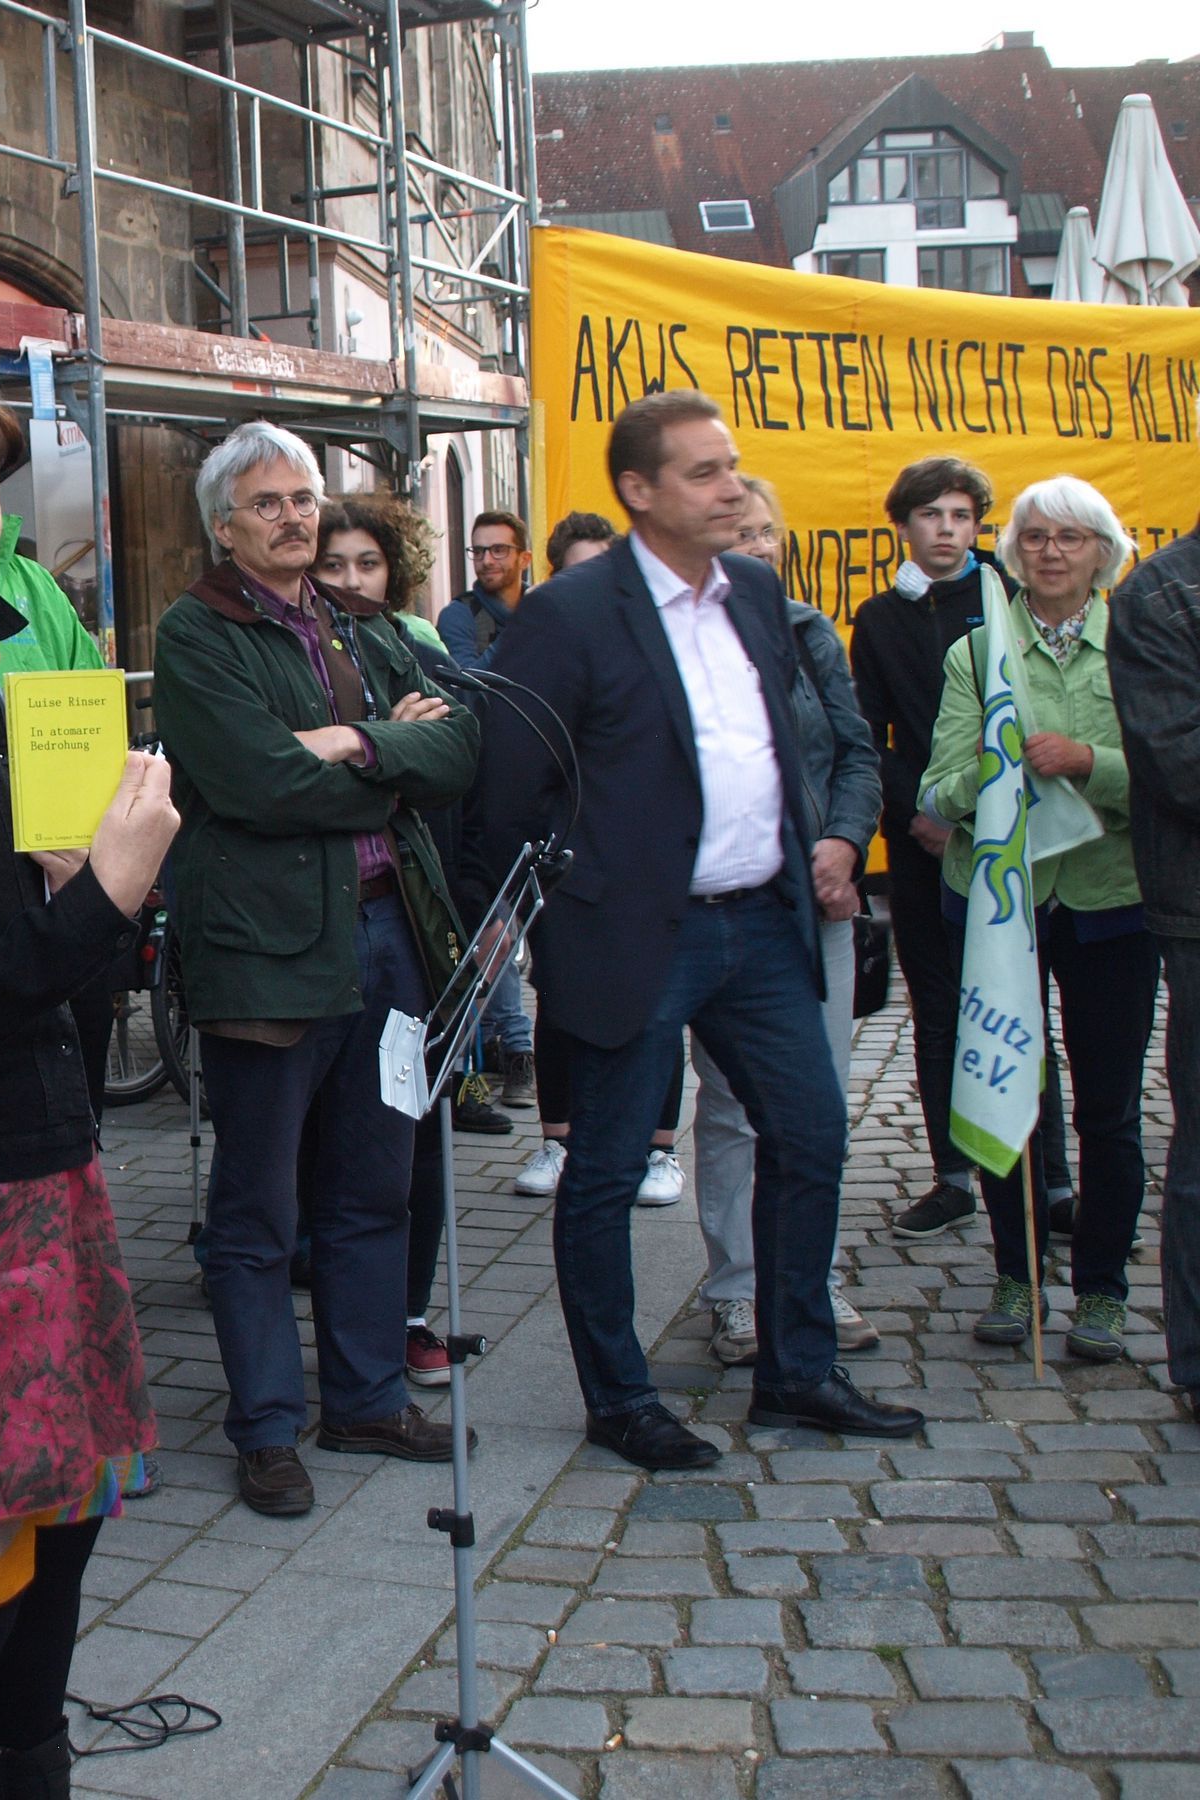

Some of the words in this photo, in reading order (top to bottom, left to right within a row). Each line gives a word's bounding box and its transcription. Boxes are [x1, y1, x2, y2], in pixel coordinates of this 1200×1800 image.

[571, 315, 699, 422] AKWS
[726, 325, 893, 431] RETTEN
[1046, 345, 1112, 439] DAS
[28, 698, 61, 708] Luise
[68, 696, 107, 707] Rinser
[31, 727, 43, 737] In
[50, 725, 101, 736] atomarer
[30, 740, 90, 751] Bedrohung
